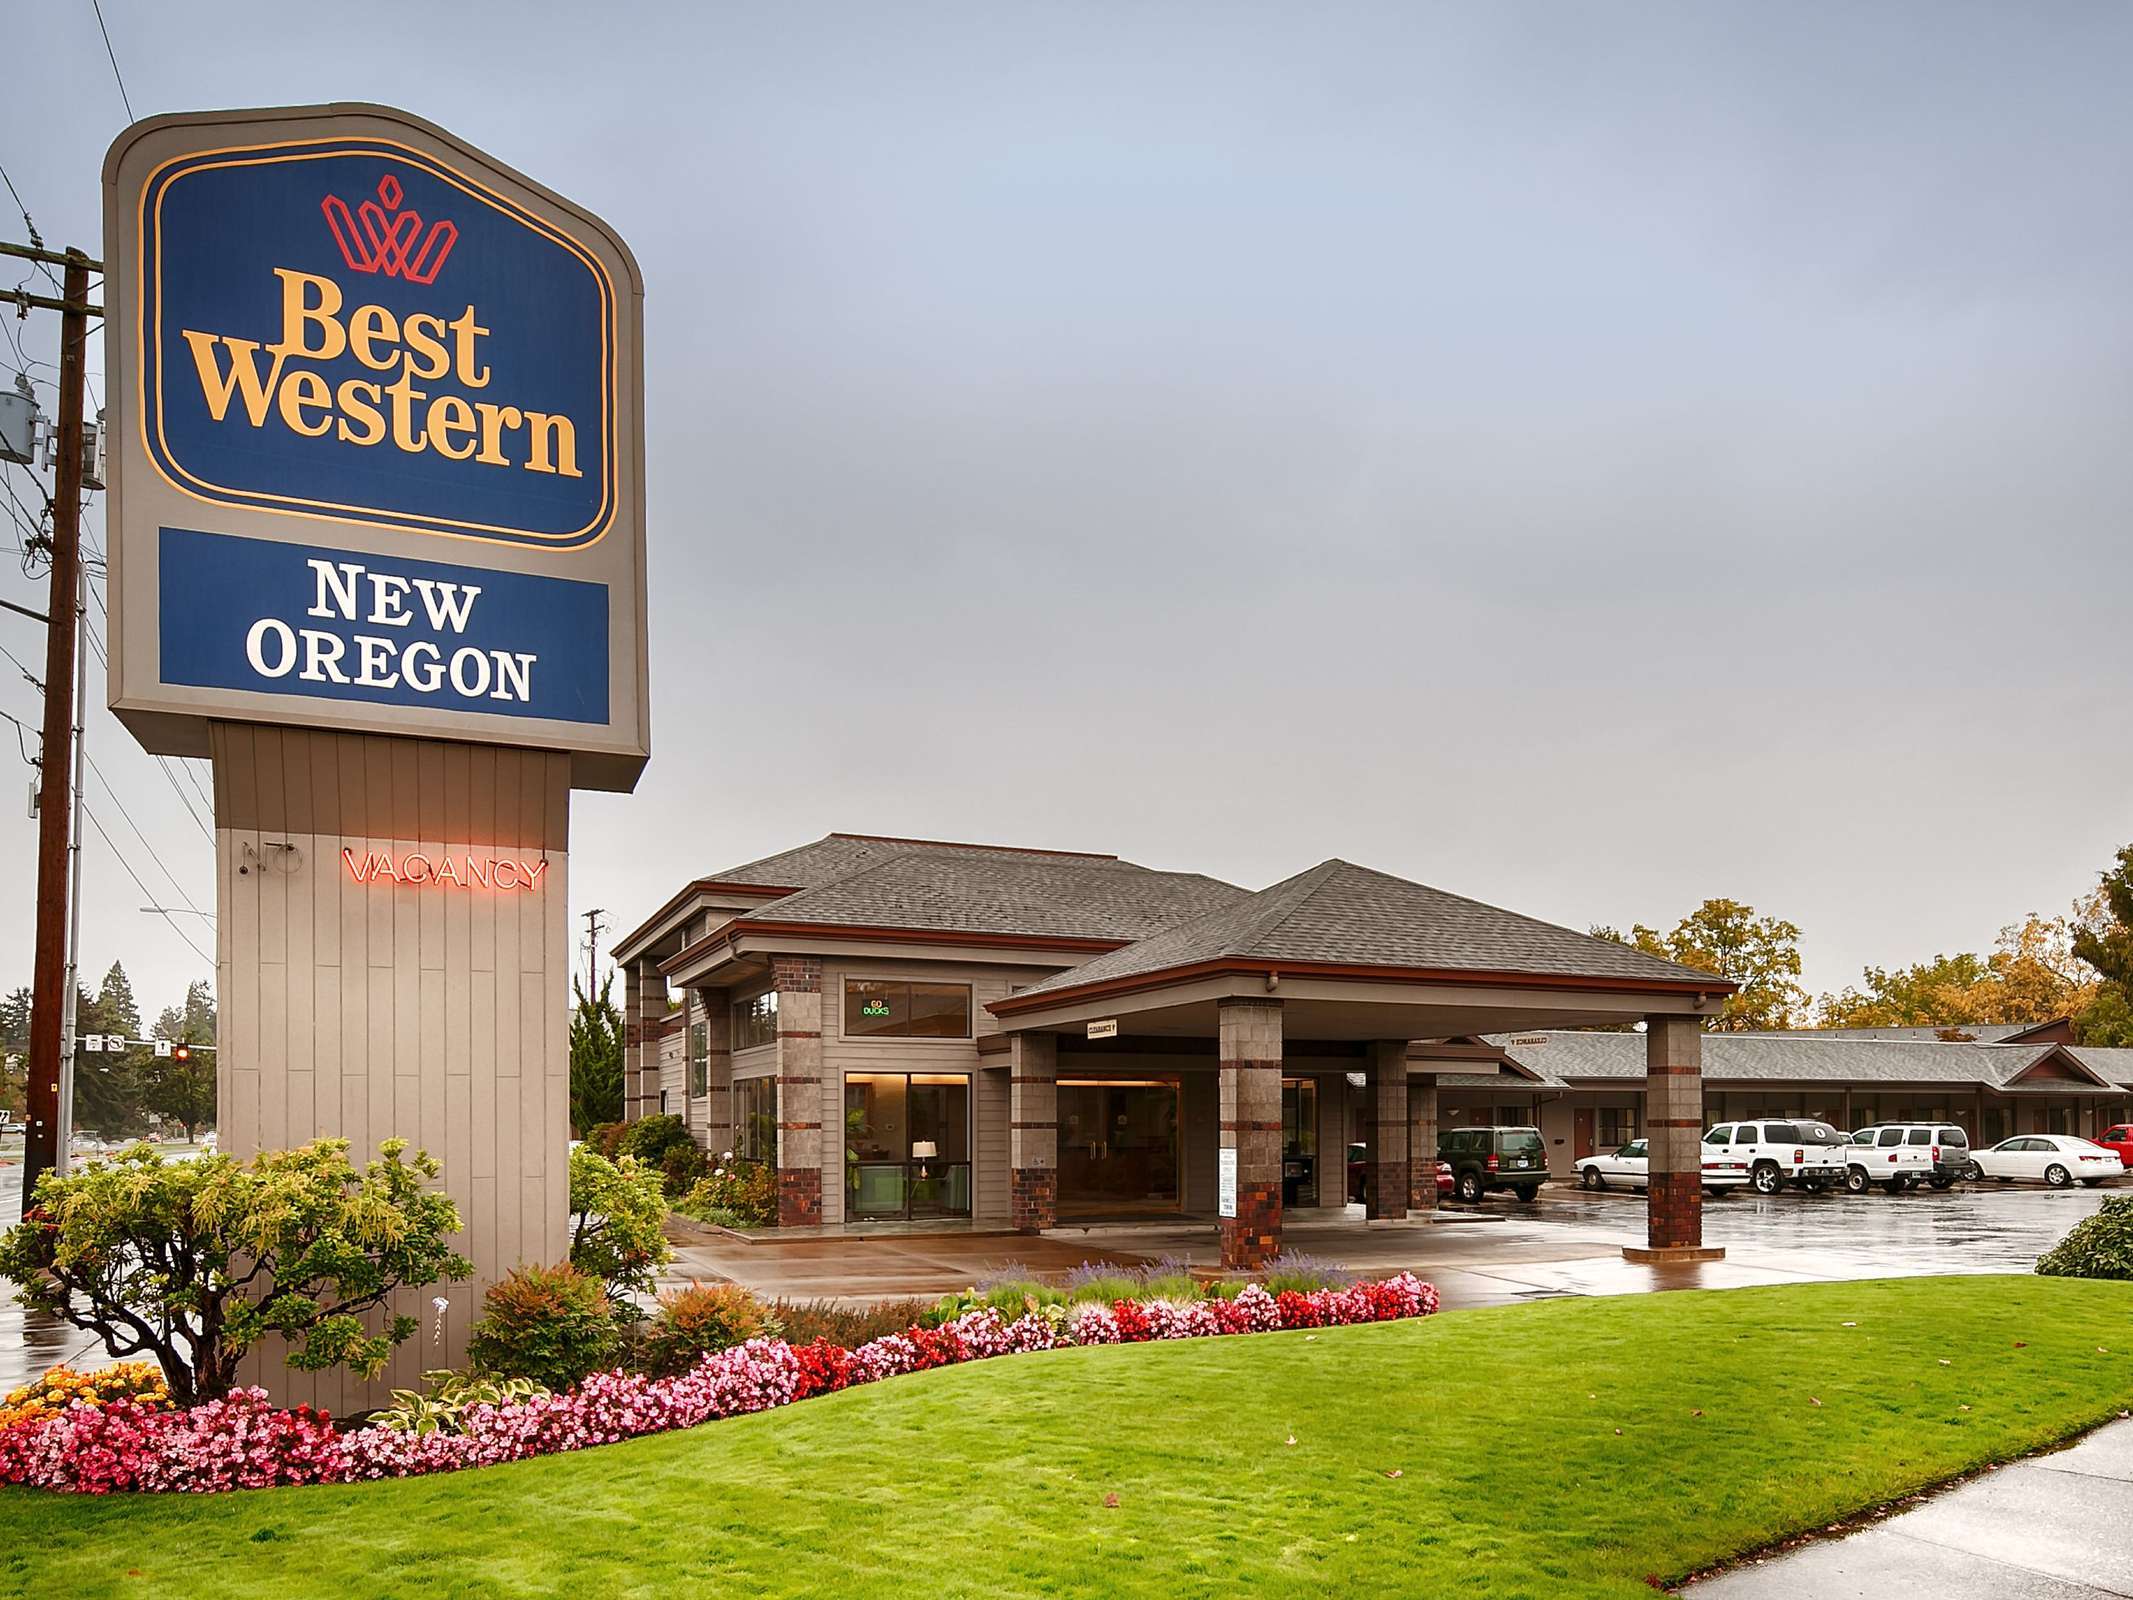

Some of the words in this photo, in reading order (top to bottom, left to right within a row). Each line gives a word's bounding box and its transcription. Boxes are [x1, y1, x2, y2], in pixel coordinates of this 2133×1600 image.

[273, 266, 491, 388] Best
[182, 329, 583, 478] Western
[306, 558, 482, 634] NEW
[245, 617, 538, 702] OREGON
[344, 849, 547, 891] VACANCY
[863, 1007, 889, 1015] DUCKS
[870, 1000, 882, 1008] GO
